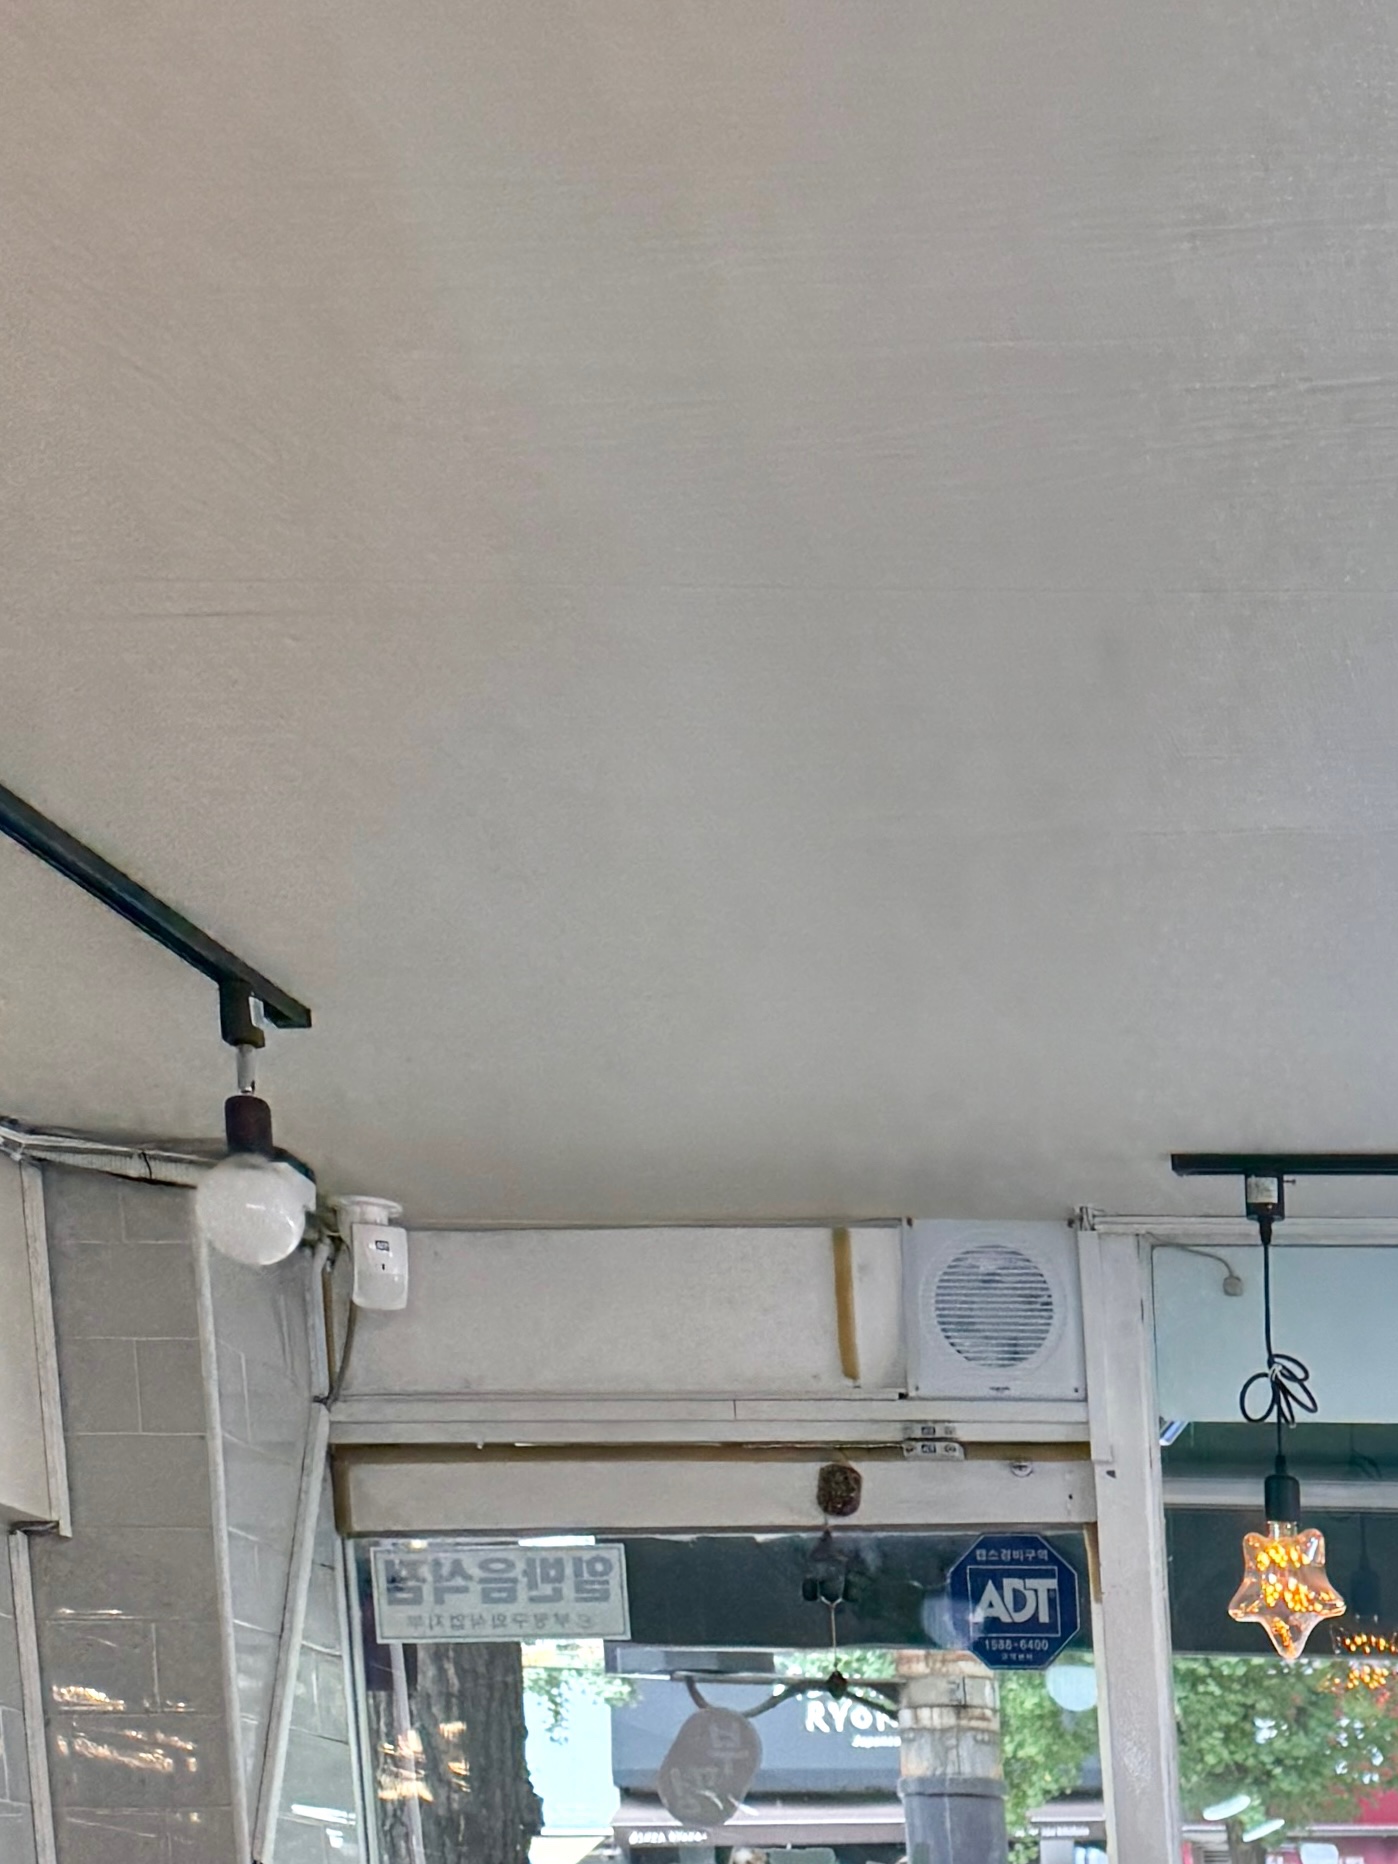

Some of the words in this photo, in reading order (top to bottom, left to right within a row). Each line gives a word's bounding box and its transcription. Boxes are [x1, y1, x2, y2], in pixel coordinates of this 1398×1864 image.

[975, 1548, 1048, 1562] 캡스경비구역
[970, 1577, 1058, 1624] ADT
[985, 1639, 1049, 1651] 1588-6400
